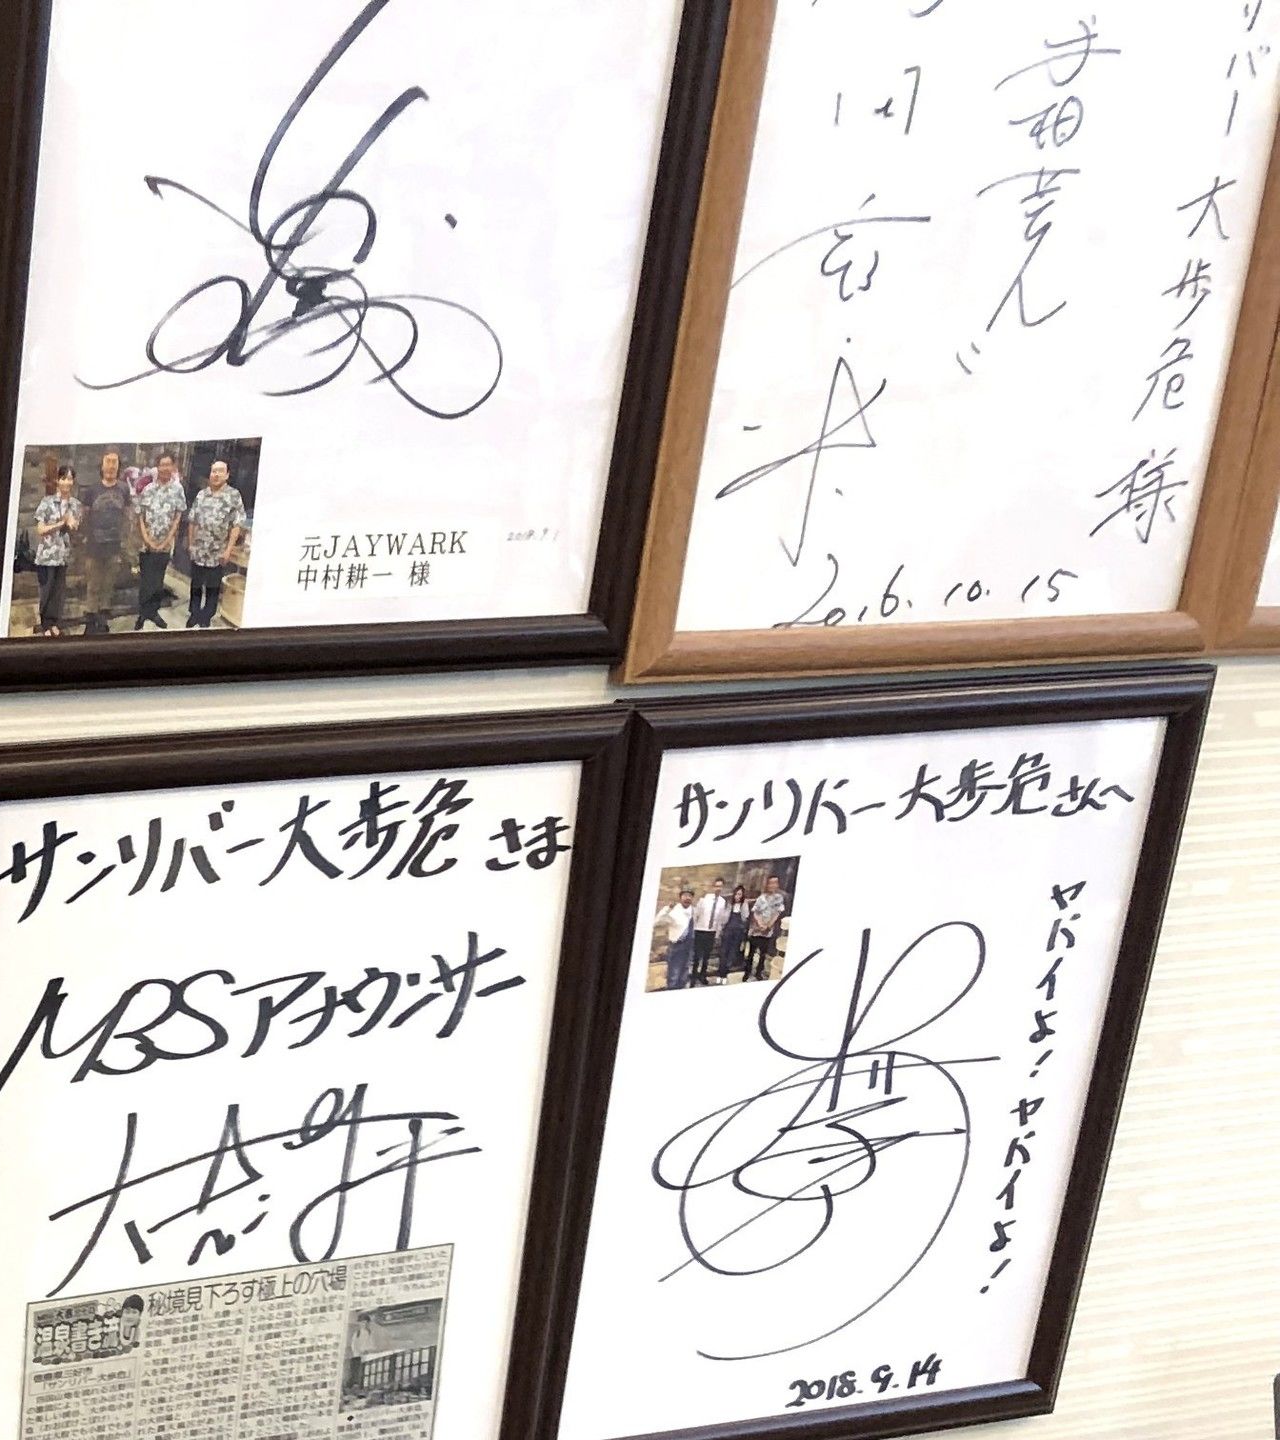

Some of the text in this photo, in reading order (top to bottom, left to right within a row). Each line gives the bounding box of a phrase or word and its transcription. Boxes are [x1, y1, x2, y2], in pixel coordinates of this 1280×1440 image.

[299, 531, 468, 561] 元JAYWARK
[297, 561, 430, 591] 中村耕一 様
[147, 1266, 347, 1316] 秘境見下ろす極上の穴場
